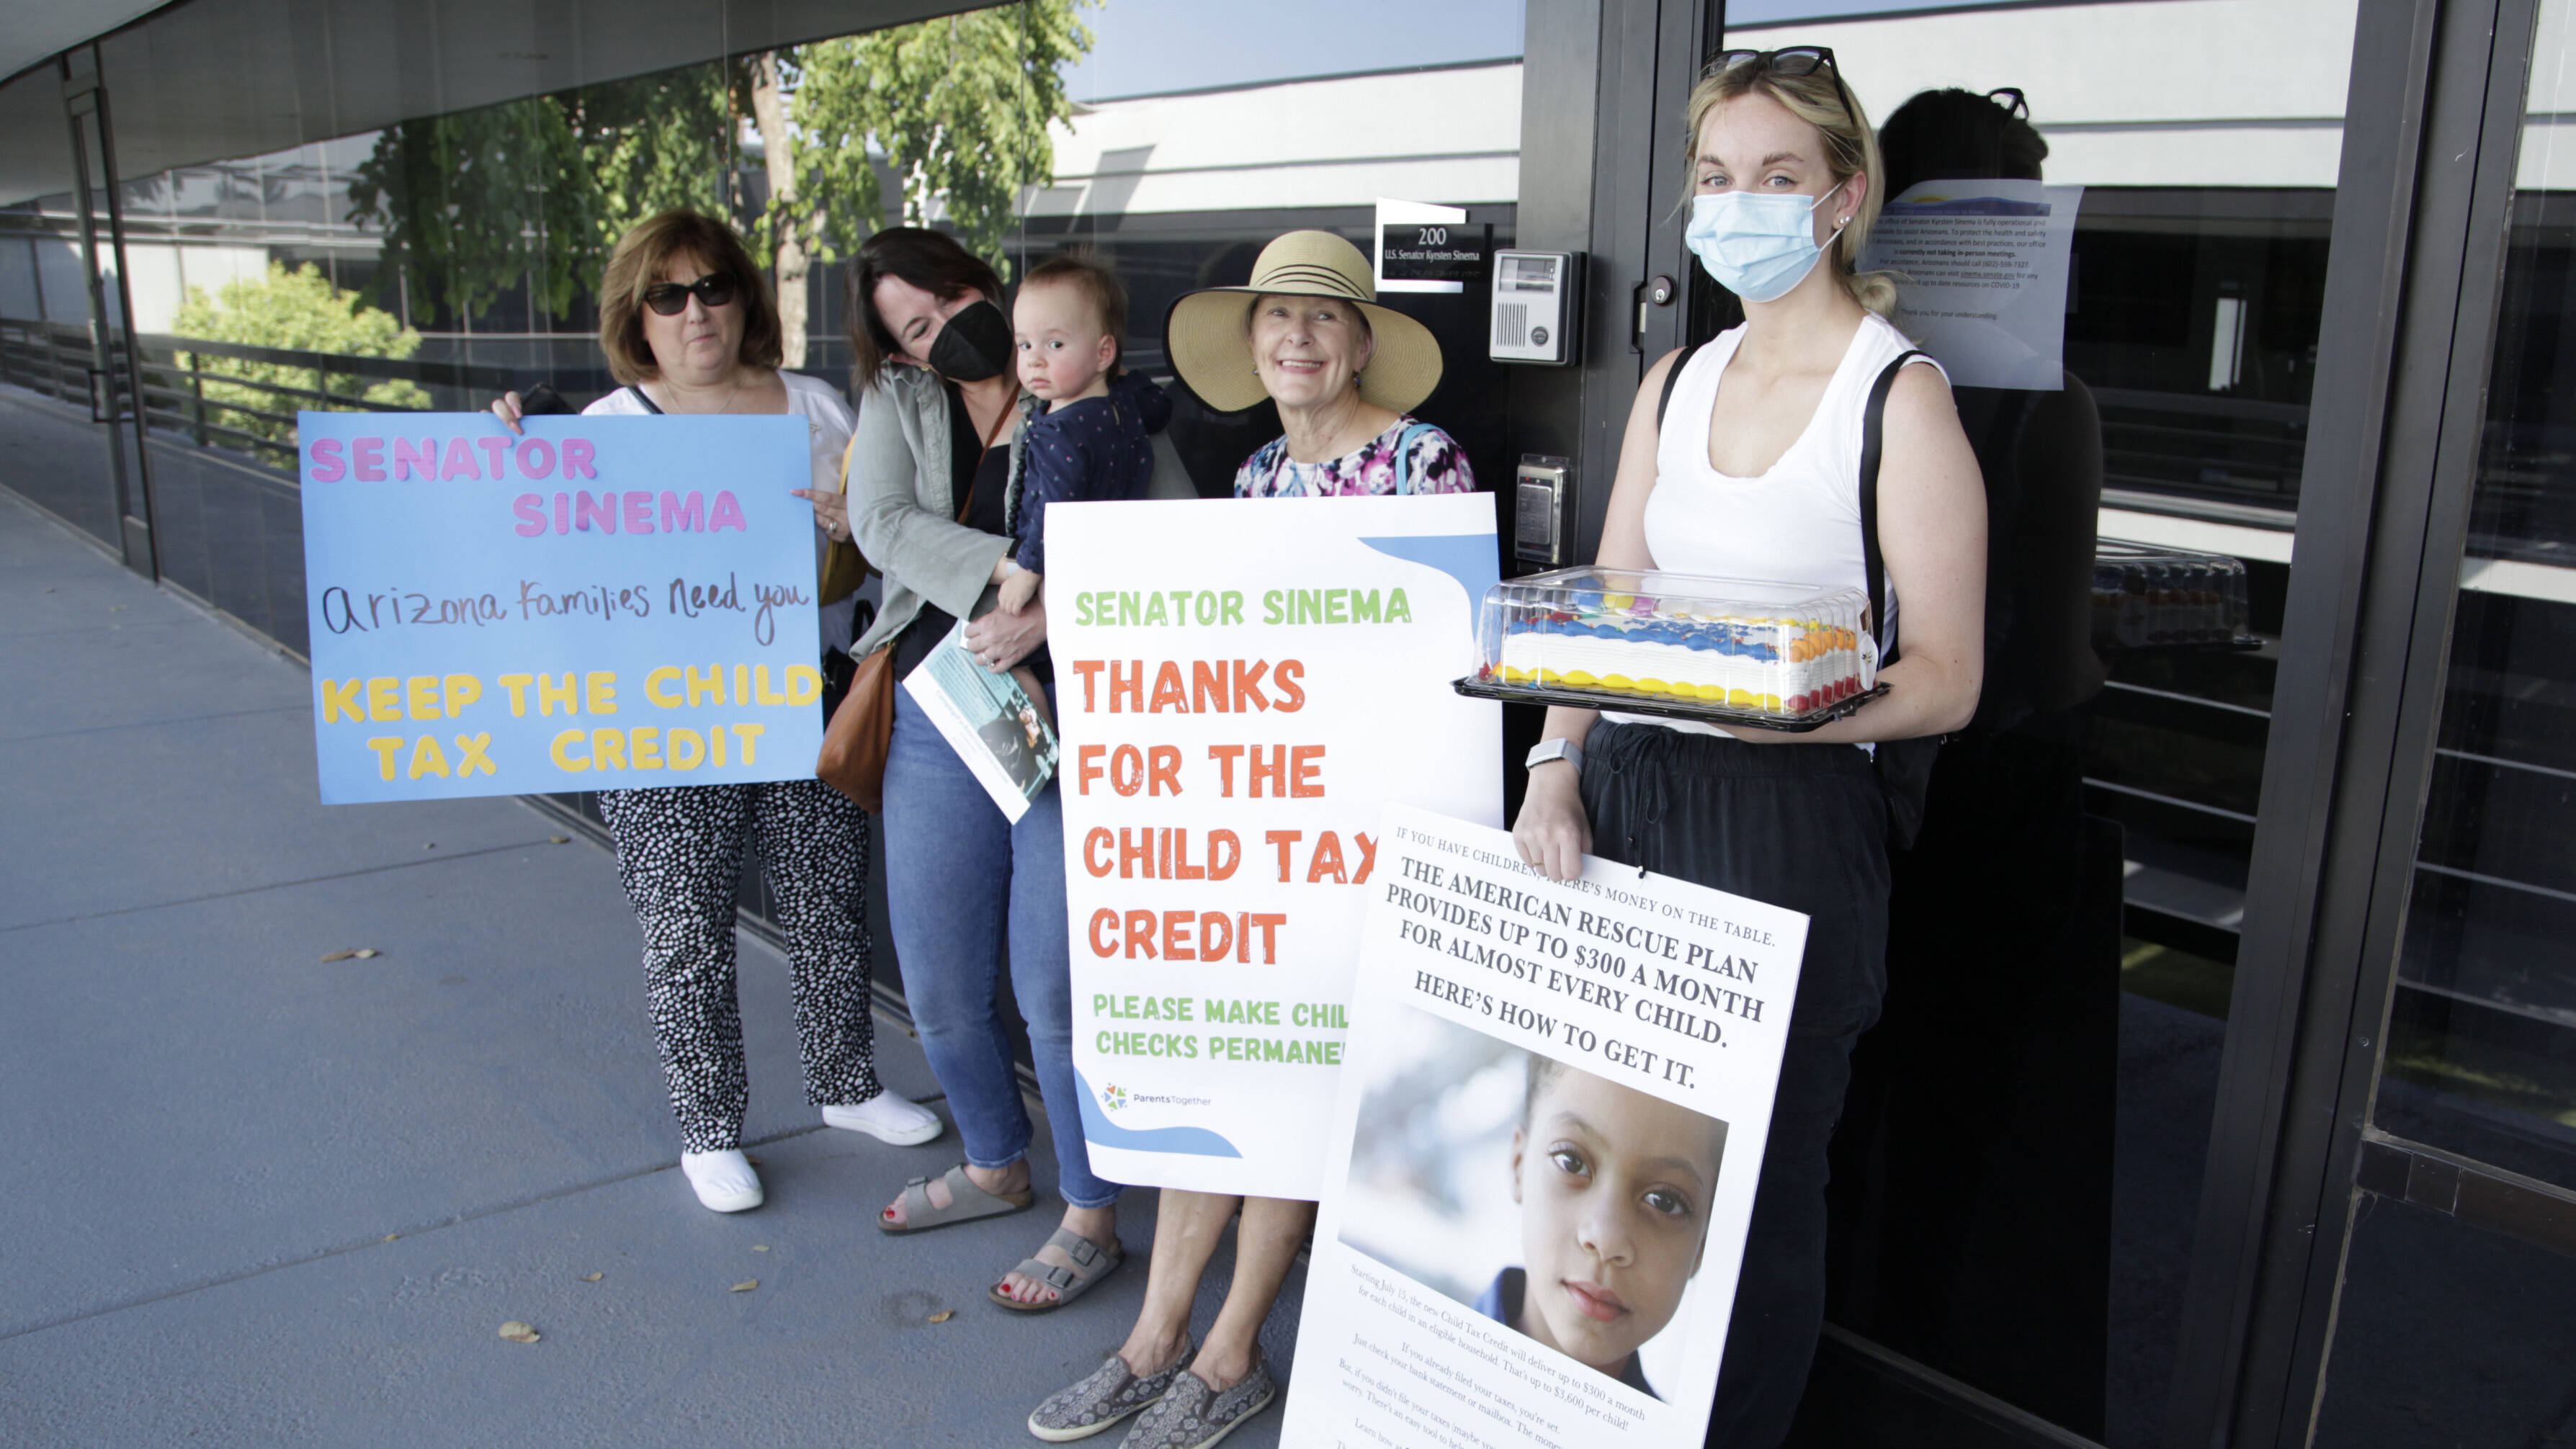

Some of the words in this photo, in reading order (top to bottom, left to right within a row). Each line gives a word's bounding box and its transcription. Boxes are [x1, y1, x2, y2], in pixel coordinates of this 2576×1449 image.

[1385, 249, 1397, 259] U.S.
[1398, 249, 1426, 260] Senator
[1426, 250, 1452, 264] Kyrsten
[1453, 250, 1480, 261] Sinema
[1418, 228, 1446, 245] 200
[309, 436, 597, 483] SENATOR
[512, 490, 746, 537] SINEMA
[754, 582, 810, 646] you
[1075, 590, 1245, 627] SENATOR
[1262, 587, 1413, 626] SINEMA
[321, 673, 483, 724] KEEP
[498, 670, 619, 718] THE
[644, 663, 823, 710] CHILD
[1073, 658, 1306, 714] THANKS
[367, 731, 497, 782] TAX
[549, 723, 766, 773] CREDIT
[1078, 743, 1183, 797] FOR
[1208, 743, 1325, 799] THE
[1083, 826, 1241, 881] CHILD
[1265, 830, 1378, 884] TAX
[1396, 826, 1408, 839] IF
[1411, 830, 1436, 847] YOU
[1438, 838, 1470, 858] HAVE
[1472, 848, 1541, 879] CHILDREN,
[1547, 877, 1601, 896] ERE'S
[1605, 887, 1658, 912] MONEY
[1662, 904, 1684, 920] ON
[1688, 910, 1719, 930] THE
[1724, 921, 1775, 947] TABLE.
[1088, 907, 1287, 965] CREDIT
[1401, 856, 1444, 888] THE
[1448, 872, 1573, 928] AMERICAN
[1576, 910, 1680, 961] RESCUE
[1684, 943, 1759, 984] PLAN
[1385, 883, 1493, 936] PROVIDES
[1498, 919, 1529, 946] UP
[1535, 930, 1569, 959] TO
[1574, 944, 1627, 979] $300
[1630, 964, 1649, 987] A
[1653, 971, 1766, 1023] MONTH
[1093, 994, 1194, 1021] PLEASE
[1205, 998, 1280, 1026] MAKE
[1292, 1002, 1349, 1029] CHIL
[1399, 918, 1443, 953] FOR
[1446, 935, 1543, 985] ALMOST
[1547, 968, 1630, 1015] EVERY
[1634, 997, 1728, 1049] CHILD.
[1096, 1031, 1198, 1059] CHECKS
[1209, 1036, 1346, 1065] PERMANE
[1414, 970, 1494, 1016] HERE'S
[1498, 1002, 1558, 1039] HOW
[1562, 1021, 1597, 1053] TO
[1604, 1037, 1659, 1075] GET
[1662, 1056, 1696, 1089] IT.
[1133, 1094, 1211, 1107] ParentsTogether
[1351, 1264, 1382, 1287] Starting
[1377, 1279, 1396, 1296] July
[1397, 1287, 1408, 1303] 15,
[1410, 1296, 1422, 1309] the
[1423, 1304, 1439, 1317] new
[1441, 1311, 1464, 1330] Child
[1465, 1322, 1481, 1339] Tax
[1482, 1331, 1509, 1352] Credit
[1511, 1348, 1526, 1362] will
[1528, 1355, 1557, 1378] deliver
[1558, 1371, 1570, 1385] up
[1572, 1377, 1580, 1389] to
[1583, 1382, 1606, 1401] $300
[1607, 1396, 1614, 1405] a
[1615, 1400, 1646, 1421] month
[1359, 1285, 1369, 1297] for
[1370, 1293, 1388, 1308] each
[1388, 1301, 1408, 1319] child
[1408, 1312, 1416, 1323] in
[1417, 1318, 1427, 1329] an
[1428, 1323, 1457, 1345] eligible
[1457, 1336, 1499, 1366] household.
[1503, 1358, 1528, 1381] That's
[1530, 1376, 1542, 1390] up
[1543, 1382, 1552, 1393] to
[1554, 1386, 1585, 1409] $3,600
[1584, 1404, 1601, 1418] per
[1602, 1412, 1629, 1432] child!
[1342, 1378, 1364, 1398] worry.
[1367, 1390, 1393, 1414] There's
[1393, 1410, 1404, 1420] an
[1405, 1415, 1422, 1432] easy
[1423, 1424, 1438, 1439] tool
[1439, 1434, 1448, 1445] to
[1353, 1332, 1367, 1349] Just
[1369, 1342, 1389, 1360] check
[1390, 1355, 1408, 1370] your
[1409, 1363, 1428, 1381] bank
[1429, 1376, 1467, 1402] statement
[1467, 1399, 1477, 1408] or
[1478, 1403, 1513, 1428] mailbox.
[1516, 1419, 1533, 1437] The
[1355, 1367, 1362, 1377] if
[1361, 1373, 1375, 1386] you
[1375, 1379, 1397, 1399] didn't
[1398, 1392, 1410, 1407] file
[1410, 1401, 1430, 1417] your
[1430, 1412, 1450, 1429] taxes
[1452, 1422, 1481, 1445] (maybe
[1401, 1341, 1410, 1353] If
[1410, 1348, 1423, 1361] you
[1425, 1356, 1454, 1378] already
[1454, 1371, 1473, 1388] filed
[1474, 1383, 1493, 1398] your
[1494, 1393, 1517, 1412] taxes,
[1519, 1407, 1545, 1426] you're
[1547, 1422, 1560, 1435] set.
[1354, 1417, 1377, 1438] Learn
[1377, 1430, 1394, 1448] how
